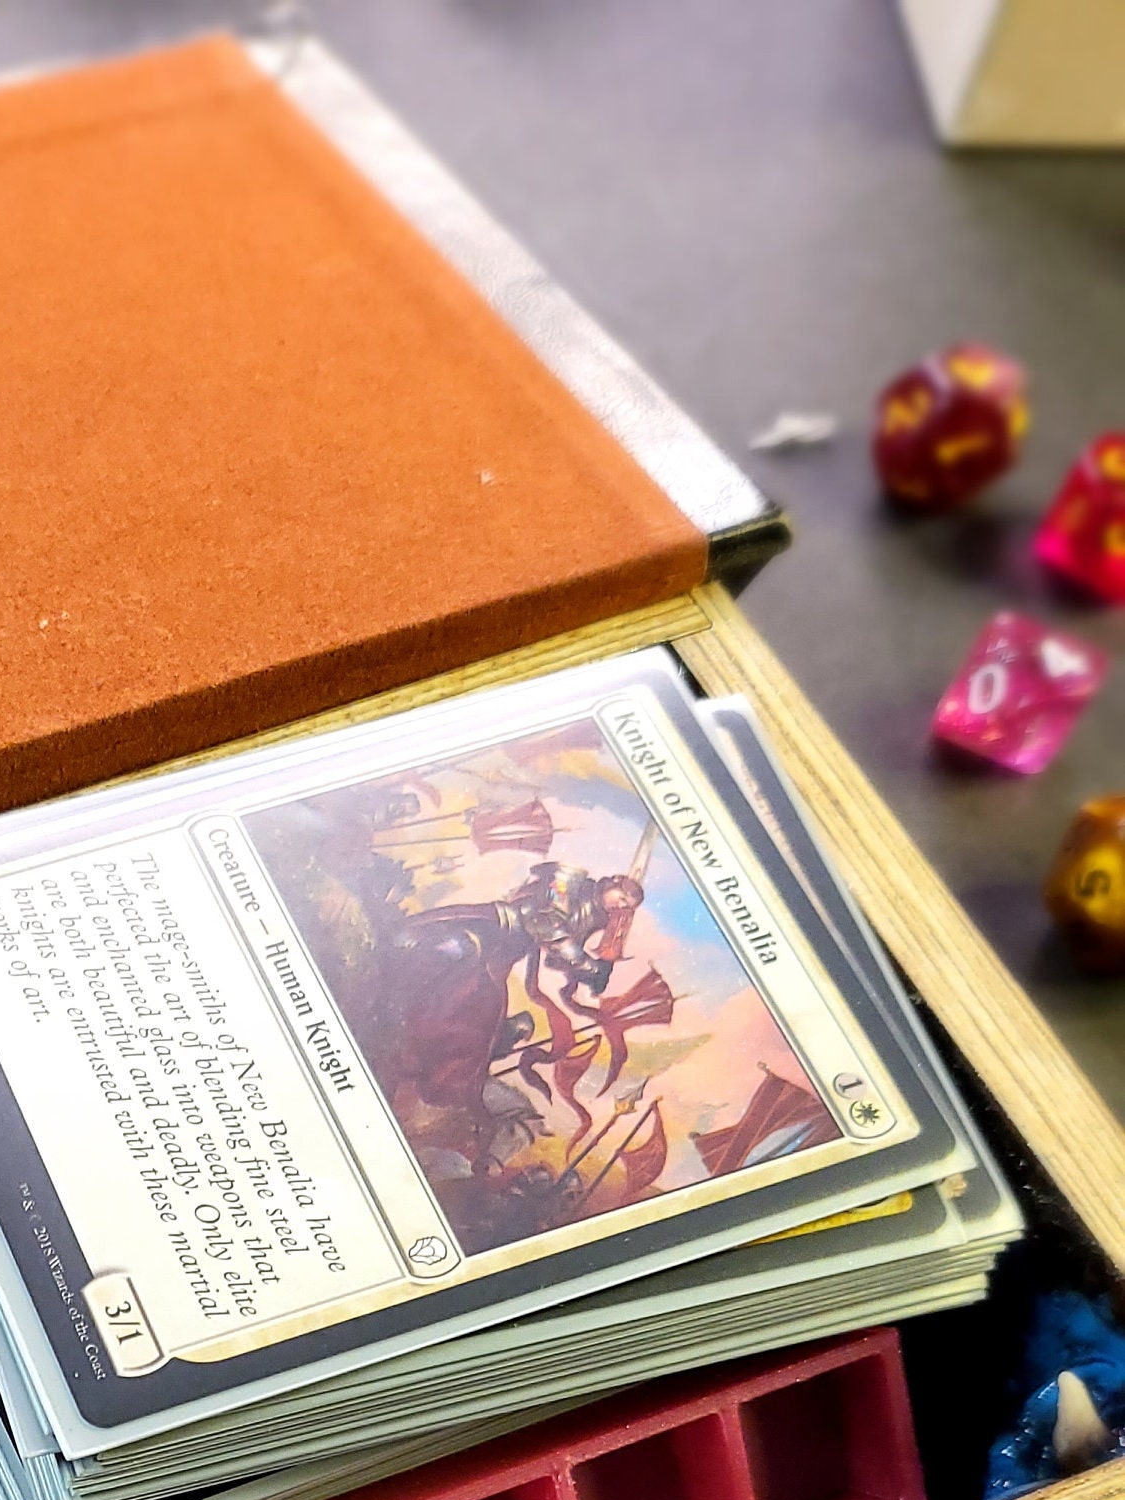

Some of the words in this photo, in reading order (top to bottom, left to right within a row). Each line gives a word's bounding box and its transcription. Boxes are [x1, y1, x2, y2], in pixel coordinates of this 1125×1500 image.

[968, 662, 1008, 715] 0
[613, 711, 673, 787] Knight
[662, 791, 693, 819] of
[679, 821, 723, 870] New
[715, 874, 779, 967] Benalia
[131, 852, 160, 891] The
[93, 861, 162, 947] perfected
[8, 959, 41, 980] of
[144, 952, 172, 984] the
[152, 897, 227, 1026] mage-smiths
[208, 827, 261, 913] Creature
[264, 939, 314, 1018] Human
[305, 1019, 357, 1094] Knight
[22, 986, 50, 1024] art.
[163, 992, 192, 1023] art
[179, 1030, 213, 1051] of
[217, 1033, 249, 1053] of
[11, 885, 57, 959] knights
[48, 966, 76, 1000] are
[66, 1006, 132, 1105] entrusted
[113, 1109, 155, 1161] with
[139, 1167, 179, 1224] these
[168, 1228, 230, 1319] martial
[41, 878, 68, 910] are
[58, 914, 97, 960] both
[82, 965, 146, 1059] beautiful
[129, 1066, 170, 1110] and
[151, 1116, 202, 1196] deadly.
[193, 1203, 235, 1262] Only
[222, 1270, 258, 1318] elite
[70, 870, 108, 908] and
[92, 915, 162, 1019] enchanted
[138, 1026, 181, 1076] glass
[171, 1083, 205, 1126] into
[195, 1132, 253, 1229] weapons
[243, 1235, 282, 1286] that
[194, 1055, 252, 1150] blending
[230, 1059, 268, 1112] New
[233, 1155, 275, 1200] fine
[259, 1119, 315, 1208] Benalia
[265, 1207, 311, 1256] steel
[305, 1215, 347, 1273] have
[21, 1199, 36, 1212] &
[32, 1225, 56, 1256] 2018
[47, 1254, 77, 1306] Wizards
[74, 1318, 90, 1343] the
[84, 1342, 107, 1381] Coast
[105, 1301, 144, 1346] 3/1
